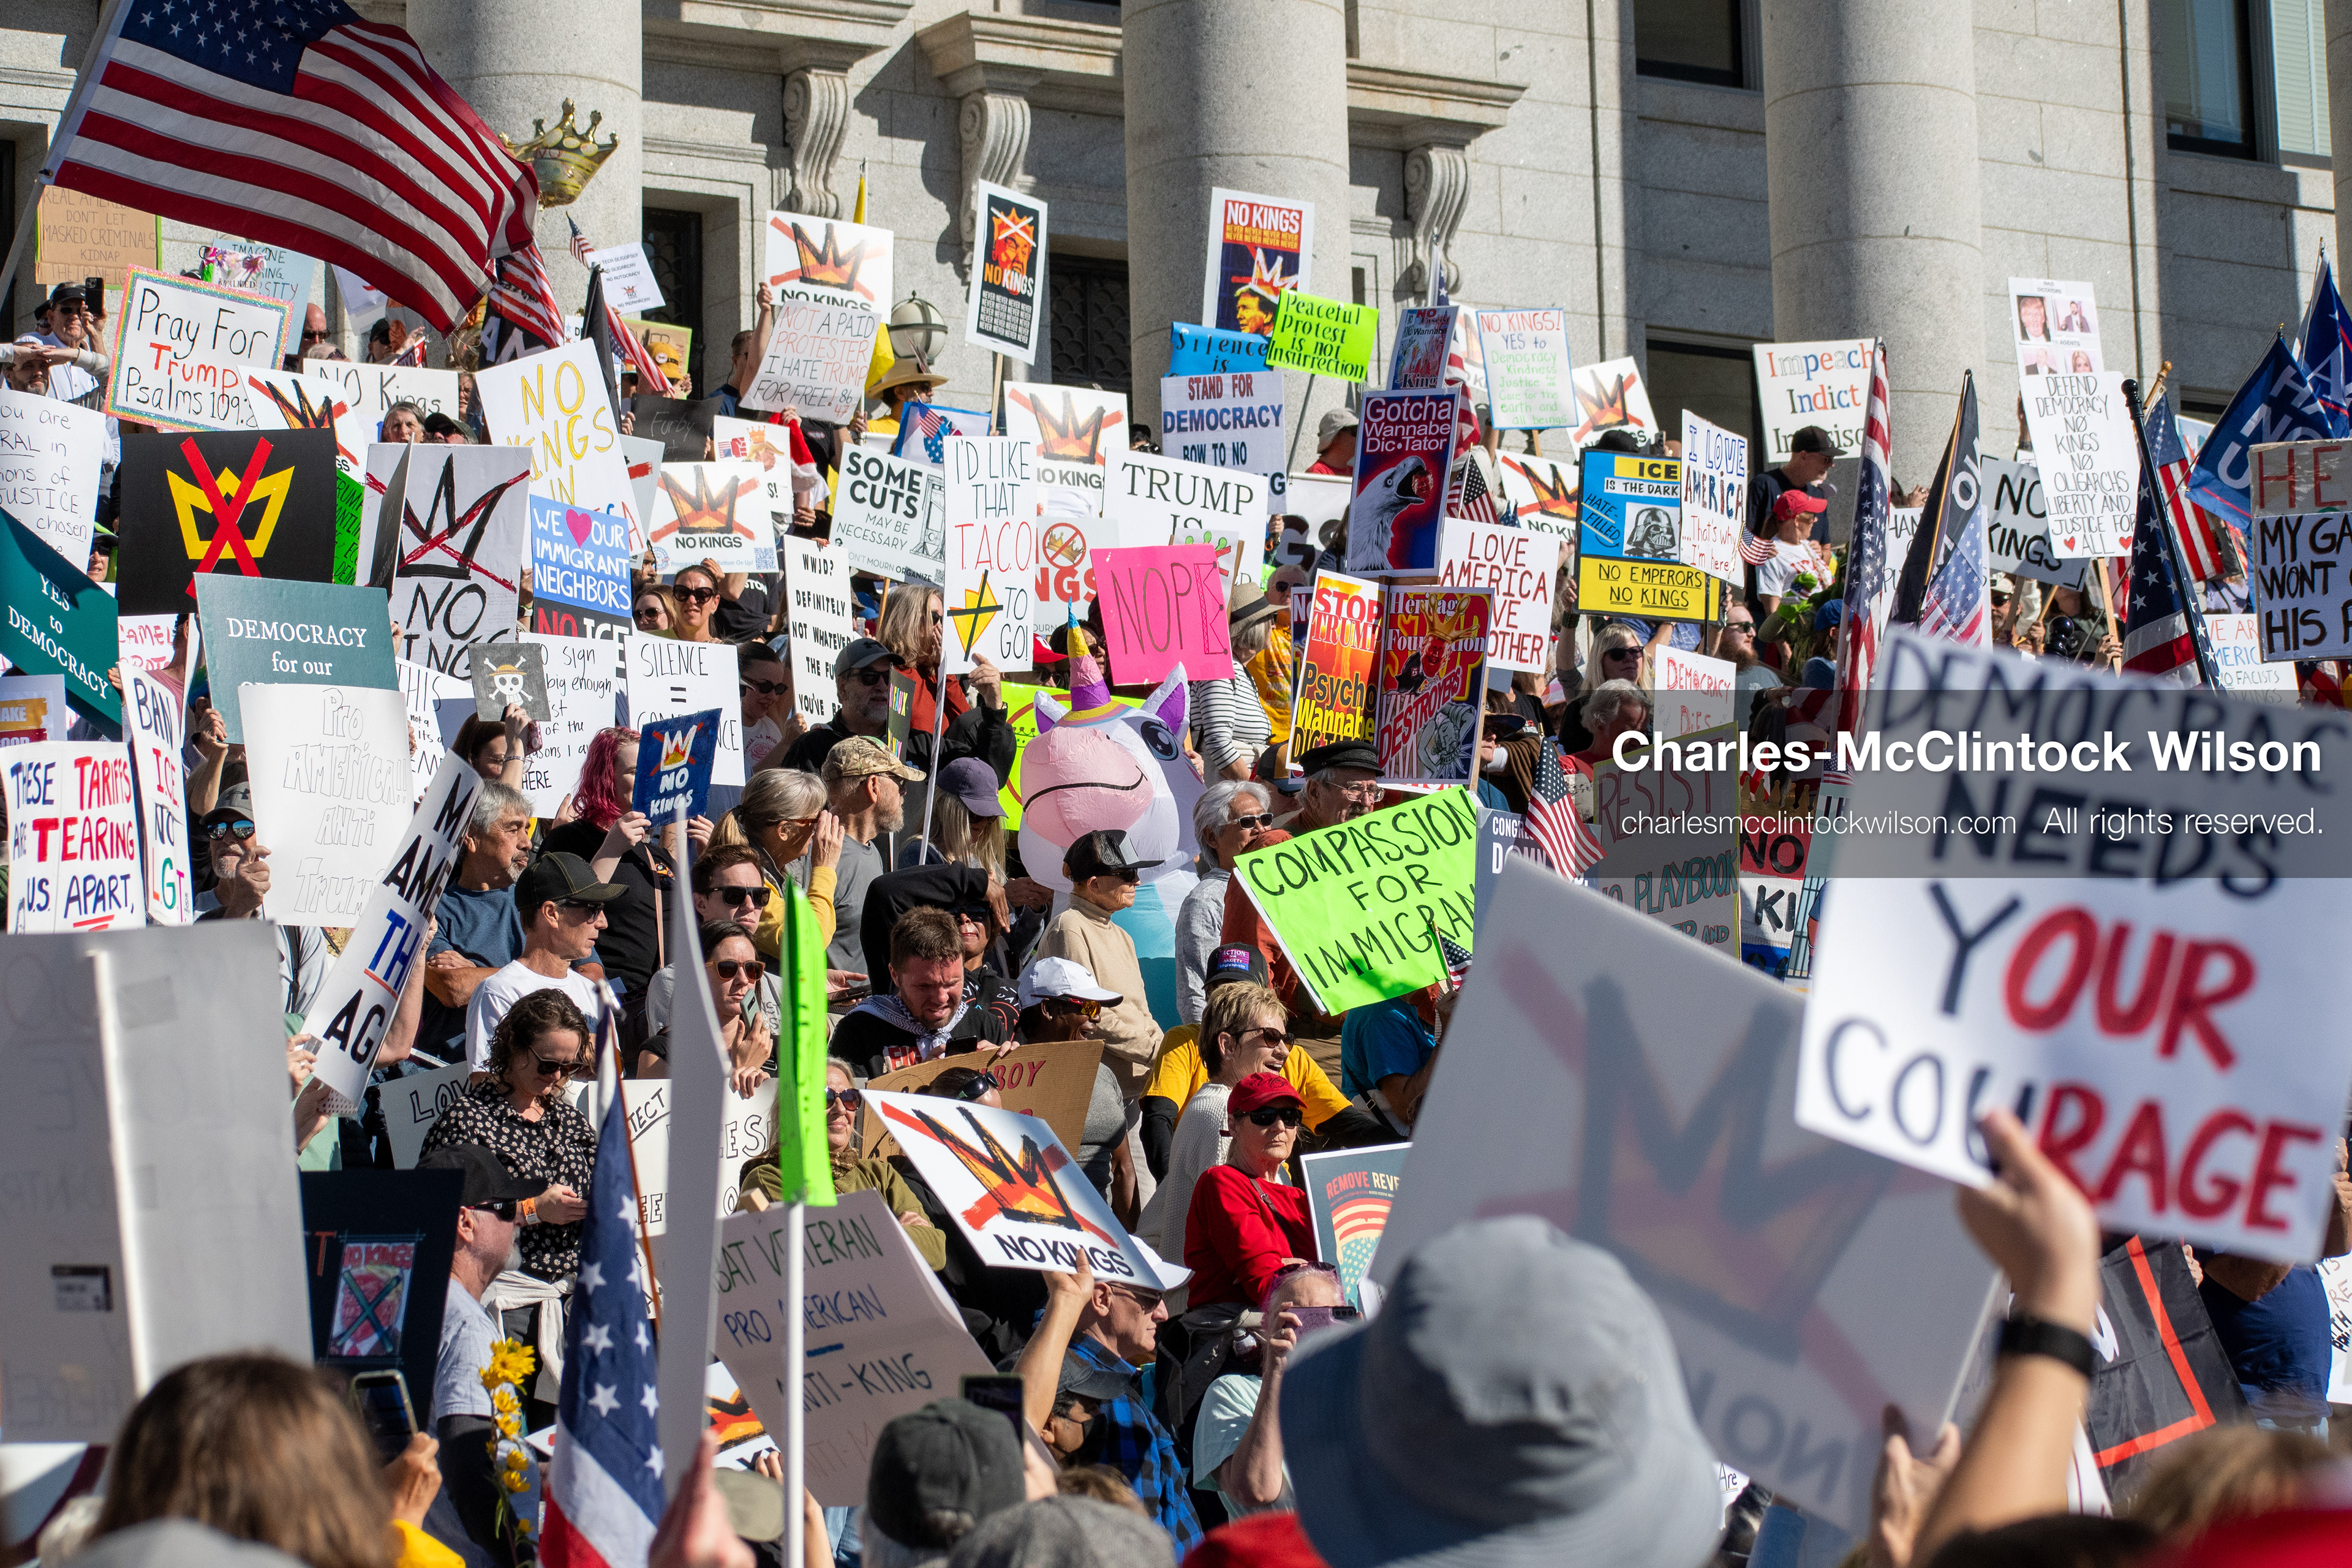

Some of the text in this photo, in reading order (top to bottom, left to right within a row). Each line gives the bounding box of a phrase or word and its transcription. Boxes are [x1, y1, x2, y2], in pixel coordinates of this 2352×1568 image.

[66, 210, 126, 225] DON'T LET
[1227, 202, 1300, 234] NO KINGS
[42, 224, 157, 251] MASKED CRIMINALS
[80, 249, 120, 262] KIDNAP
[984, 262, 1034, 298] NO KINGS
[779, 306, 876, 338] NOT A PAID
[1286, 292, 1360, 325] Peaceful
[1480, 310, 1561, 333] NO KINGS!
[138, 288, 269, 360] Pray For
[774, 331, 869, 363] PROTESTER
[1175, 328, 1267, 356] Silence
[1291, 334, 1340, 360] is not
[1502, 334, 1546, 350] YES to
[765, 355, 869, 387] I HATE TRUMP
[1213, 356, 1228, 373] is
[1268, 340, 1364, 379] Insurrection
[1491, 350, 1557, 366] Democracy
[1506, 364, 1556, 374] Kindness
[1766, 343, 1874, 380] Impeach
[149, 342, 239, 404] Trump
[1188, 374, 1254, 401] STAND FOR
[1499, 377, 1540, 387] Justice
[2046, 376, 2097, 396] DEFEND
[126, 366, 204, 417] Psalms
[521, 361, 585, 424] NO
[753, 380, 853, 407] FOR FREE! 86
[1499, 390, 1521, 400] Care
[1787, 383, 1861, 413] Indict
[39, 410, 71, 430] are
[834, 403, 849, 418] 47
[1164, 404, 1283, 434] DEMOCRACY
[1366, 397, 1452, 422] Gotcha
[1501, 402, 1558, 413] earth and
[2036, 395, 2108, 420] DEMOCRACY
[1365, 421, 1451, 437] Wannabe
[2055, 432, 2099, 454] KINGS
[51, 440, 67, 457] in
[956, 439, 1031, 484] I'D LIKE
[1213, 441, 1247, 466] TO NO
[1689, 425, 1745, 477] I LOVE
[51, 466, 70, 485] of
[846, 451, 922, 495] SOME
[1638, 462, 1678, 480] ICE
[2054, 471, 2129, 494] OLIGARCHS
[850, 481, 918, 519] CUTS
[972, 483, 1020, 519] THAT
[1121, 462, 1254, 516] TRUMP
[1605, 480, 1679, 497] IS THE DARK
[2046, 494, 2130, 515] LIBERTY AND
[36, 515, 87, 540] chosen
[533, 508, 625, 551] WE OUR
[837, 522, 908, 551] NECESSARY
[865, 513, 910, 535] MAY BE
[1585, 513, 1621, 541] FILLED
[2052, 516, 2106, 535] JUSTICE
[675, 537, 742, 549] NO KINGS
[1468, 532, 1529, 567] LOVE
[2082, 533, 2115, 556] ALL
[2259, 515, 2302, 565] MY
[536, 538, 630, 579] IMMIGRANT
[802, 553, 834, 576] WWJD?
[867, 557, 932, 582] MOURN ORGANIZE
[1691, 545, 1706, 566] I'm
[534, 563, 631, 611] NEIGHBORS
[1440, 559, 1548, 605] AMERICA
[1599, 564, 1702, 587] NO EMPERORS
[2258, 560, 2339, 601] WONT
[39, 573, 70, 612] YES
[796, 589, 846, 617] DEFINITELY
[1005, 587, 1028, 620] TO
[1316, 588, 1382, 624] STOP
[1610, 587, 1689, 607] NO KINGS
[50, 614, 63, 634] to
[407, 581, 486, 640] NO
[227, 617, 367, 648] DEMOCRACY
[792, 620, 808, 639] NOT
[1001, 624, 1029, 661] GO!
[1312, 610, 1382, 652] TRUMP
[2266, 607, 2327, 654] HIS
[7, 605, 109, 700] DEMOCRACY
[272, 650, 333, 676] for our
[641, 643, 708, 677] SILENCE
[805, 656, 821, 677] THE
[546, 674, 611, 698] big enough
[1302, 662, 1377, 712] Psycho
[1667, 657, 1730, 704] DEMOCRACY
[2236, 670, 2279, 685] FACISTS
[134, 677, 173, 750] BAN
[323, 687, 363, 740] Pro
[799, 693, 824, 716] YOU'VE
[1298, 697, 1376, 739] Wannabe
[1379, 667, 1461, 769] DESTROYERS
[545, 720, 584, 736] of the
[10, 755, 132, 810] THESE TARIFFS
[660, 771, 689, 793] NO
[649, 789, 693, 817] KINGS
[13, 816, 135, 862] ARE TEARING
[1248, 788, 1477, 896] COMPASSION
[65, 873, 134, 914] APART,
[1347, 864, 1442, 911] FOR
[1635, 848, 1738, 914] PLAYBOOK
[1923, 884, 2257, 1072] YOUR
[1326, 1171, 1370, 1200] REMOVE
[993, 1232, 1134, 1279] NO KINGS
[725, 1310, 772, 1348] PRO
